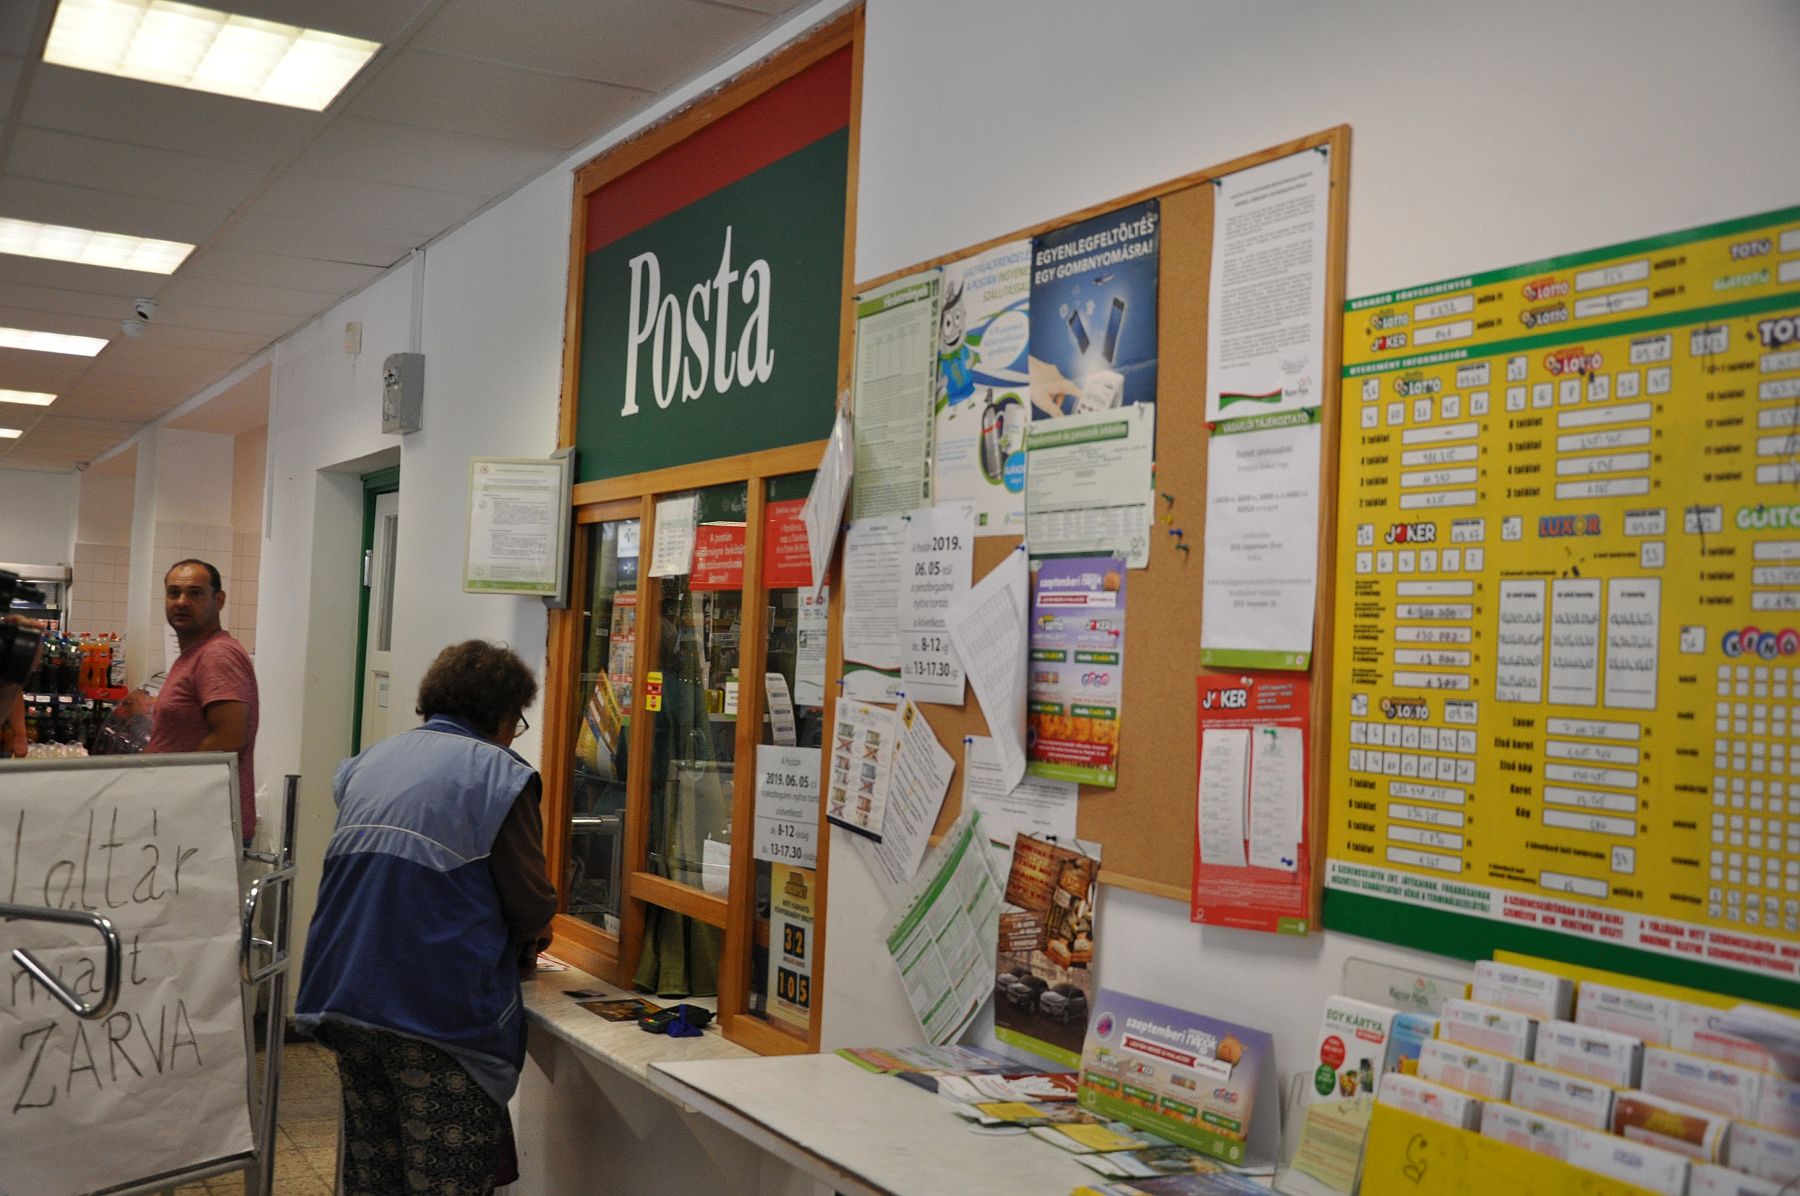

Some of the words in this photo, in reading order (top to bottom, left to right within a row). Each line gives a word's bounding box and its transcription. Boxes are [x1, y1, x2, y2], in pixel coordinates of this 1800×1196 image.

[1036, 214, 1155, 267] EGYENLEGFELTÖLTÉS
[1034, 268, 1057, 284] EGY
[1057, 239, 1155, 279] GOMBNYOMÁSRA!
[621, 225, 774, 417] Posta
[1370, 332, 1408, 353] JOKER
[1384, 521, 1437, 545] JOKER
[1538, 513, 1602, 539] LUXOR
[932, 536, 962, 551] 2019.
[1203, 688, 1248, 711] JOKER
[1326, 1008, 1346, 1024] EGY
